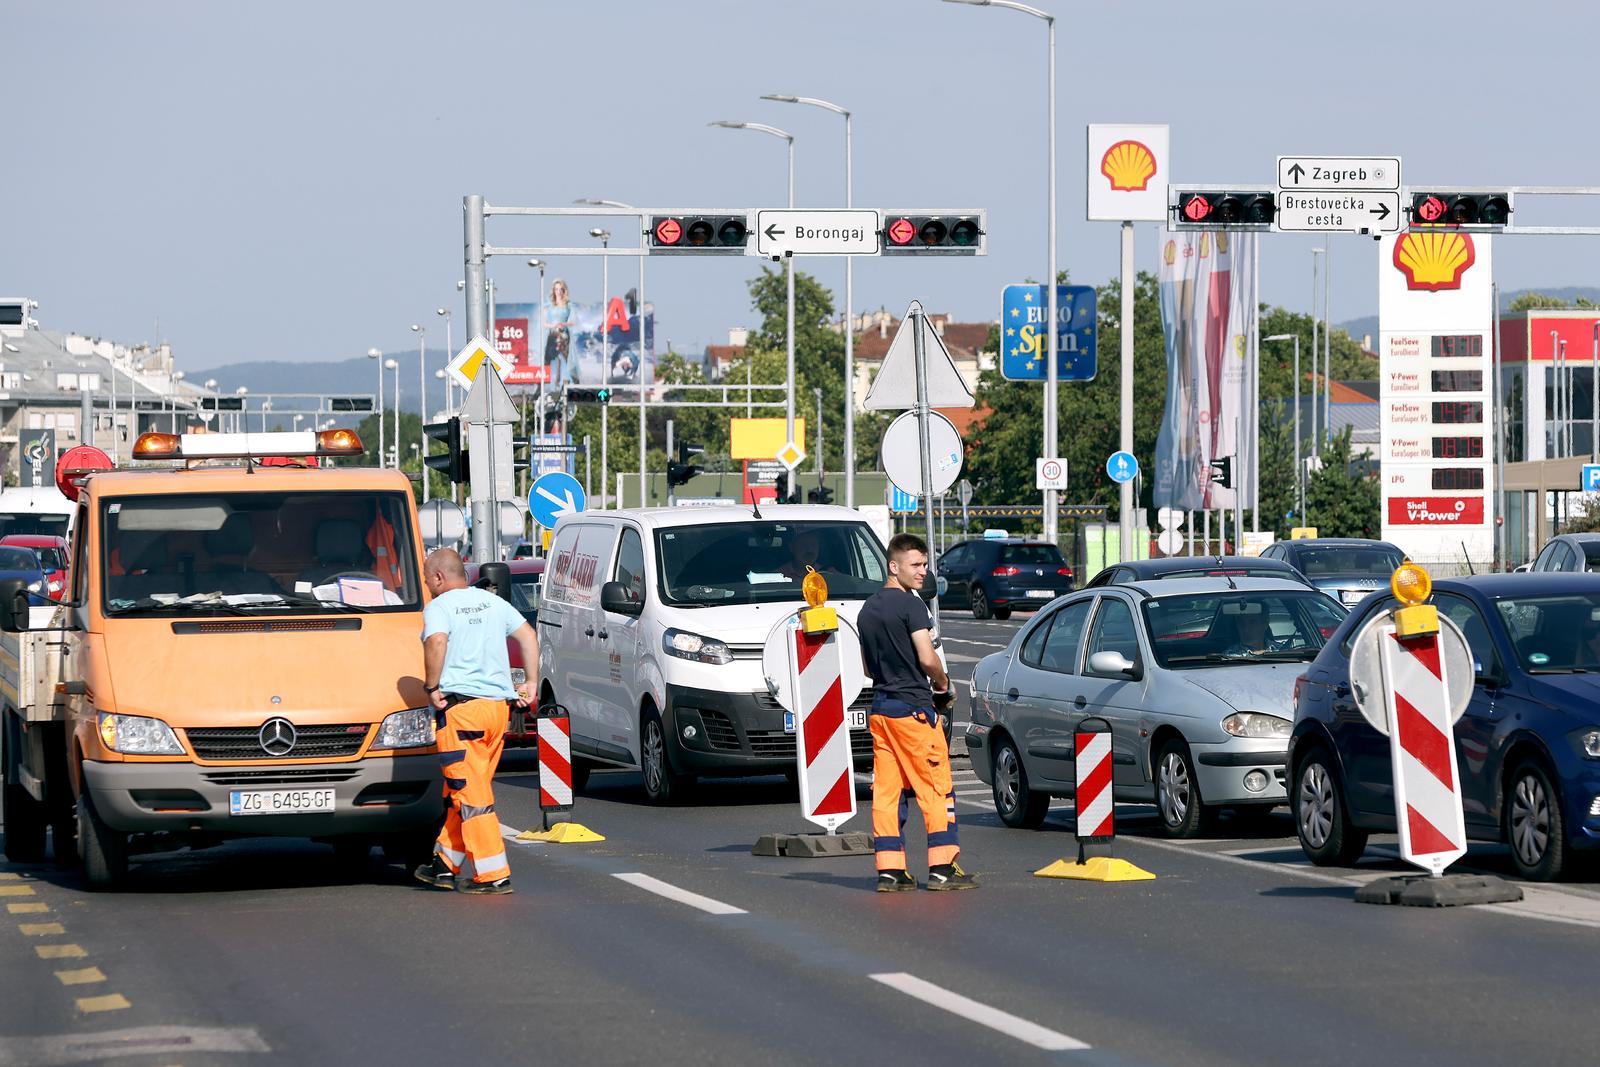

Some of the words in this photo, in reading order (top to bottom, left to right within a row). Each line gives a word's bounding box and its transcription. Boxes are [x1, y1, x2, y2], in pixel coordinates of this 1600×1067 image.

[1312, 167, 1367, 184] Zagreb
[1286, 196, 1364, 210] Brestovečka
[1307, 213, 1343, 226] cesta
[795, 226, 864, 242] Borongaj
[1027, 306, 1072, 323] EUO
[502, 325, 524, 339] što
[1019, 324, 1079, 361] Spn
[1390, 337, 1419, 346] FuelSave
[1390, 348, 1420, 356] EuroDiesel
[1390, 372, 1418, 381] V-Power
[1391, 403, 1420, 412] FuelSave
[1391, 414, 1419, 423] EuroSuper
[1420, 413, 1428, 422] 95
[1391, 438, 1419, 447] V-Power
[1391, 449, 1419, 458] EuroSuper
[1420, 448, 1431, 457] 100
[1046, 465, 1058, 476] 30
[1391, 475, 1405, 484] LPG
[1406, 501, 1428, 510] Shell
[1407, 510, 1461, 521] V-Power
[243, 793, 262, 810] ZG
[272, 791, 333, 809] 6495-GF
